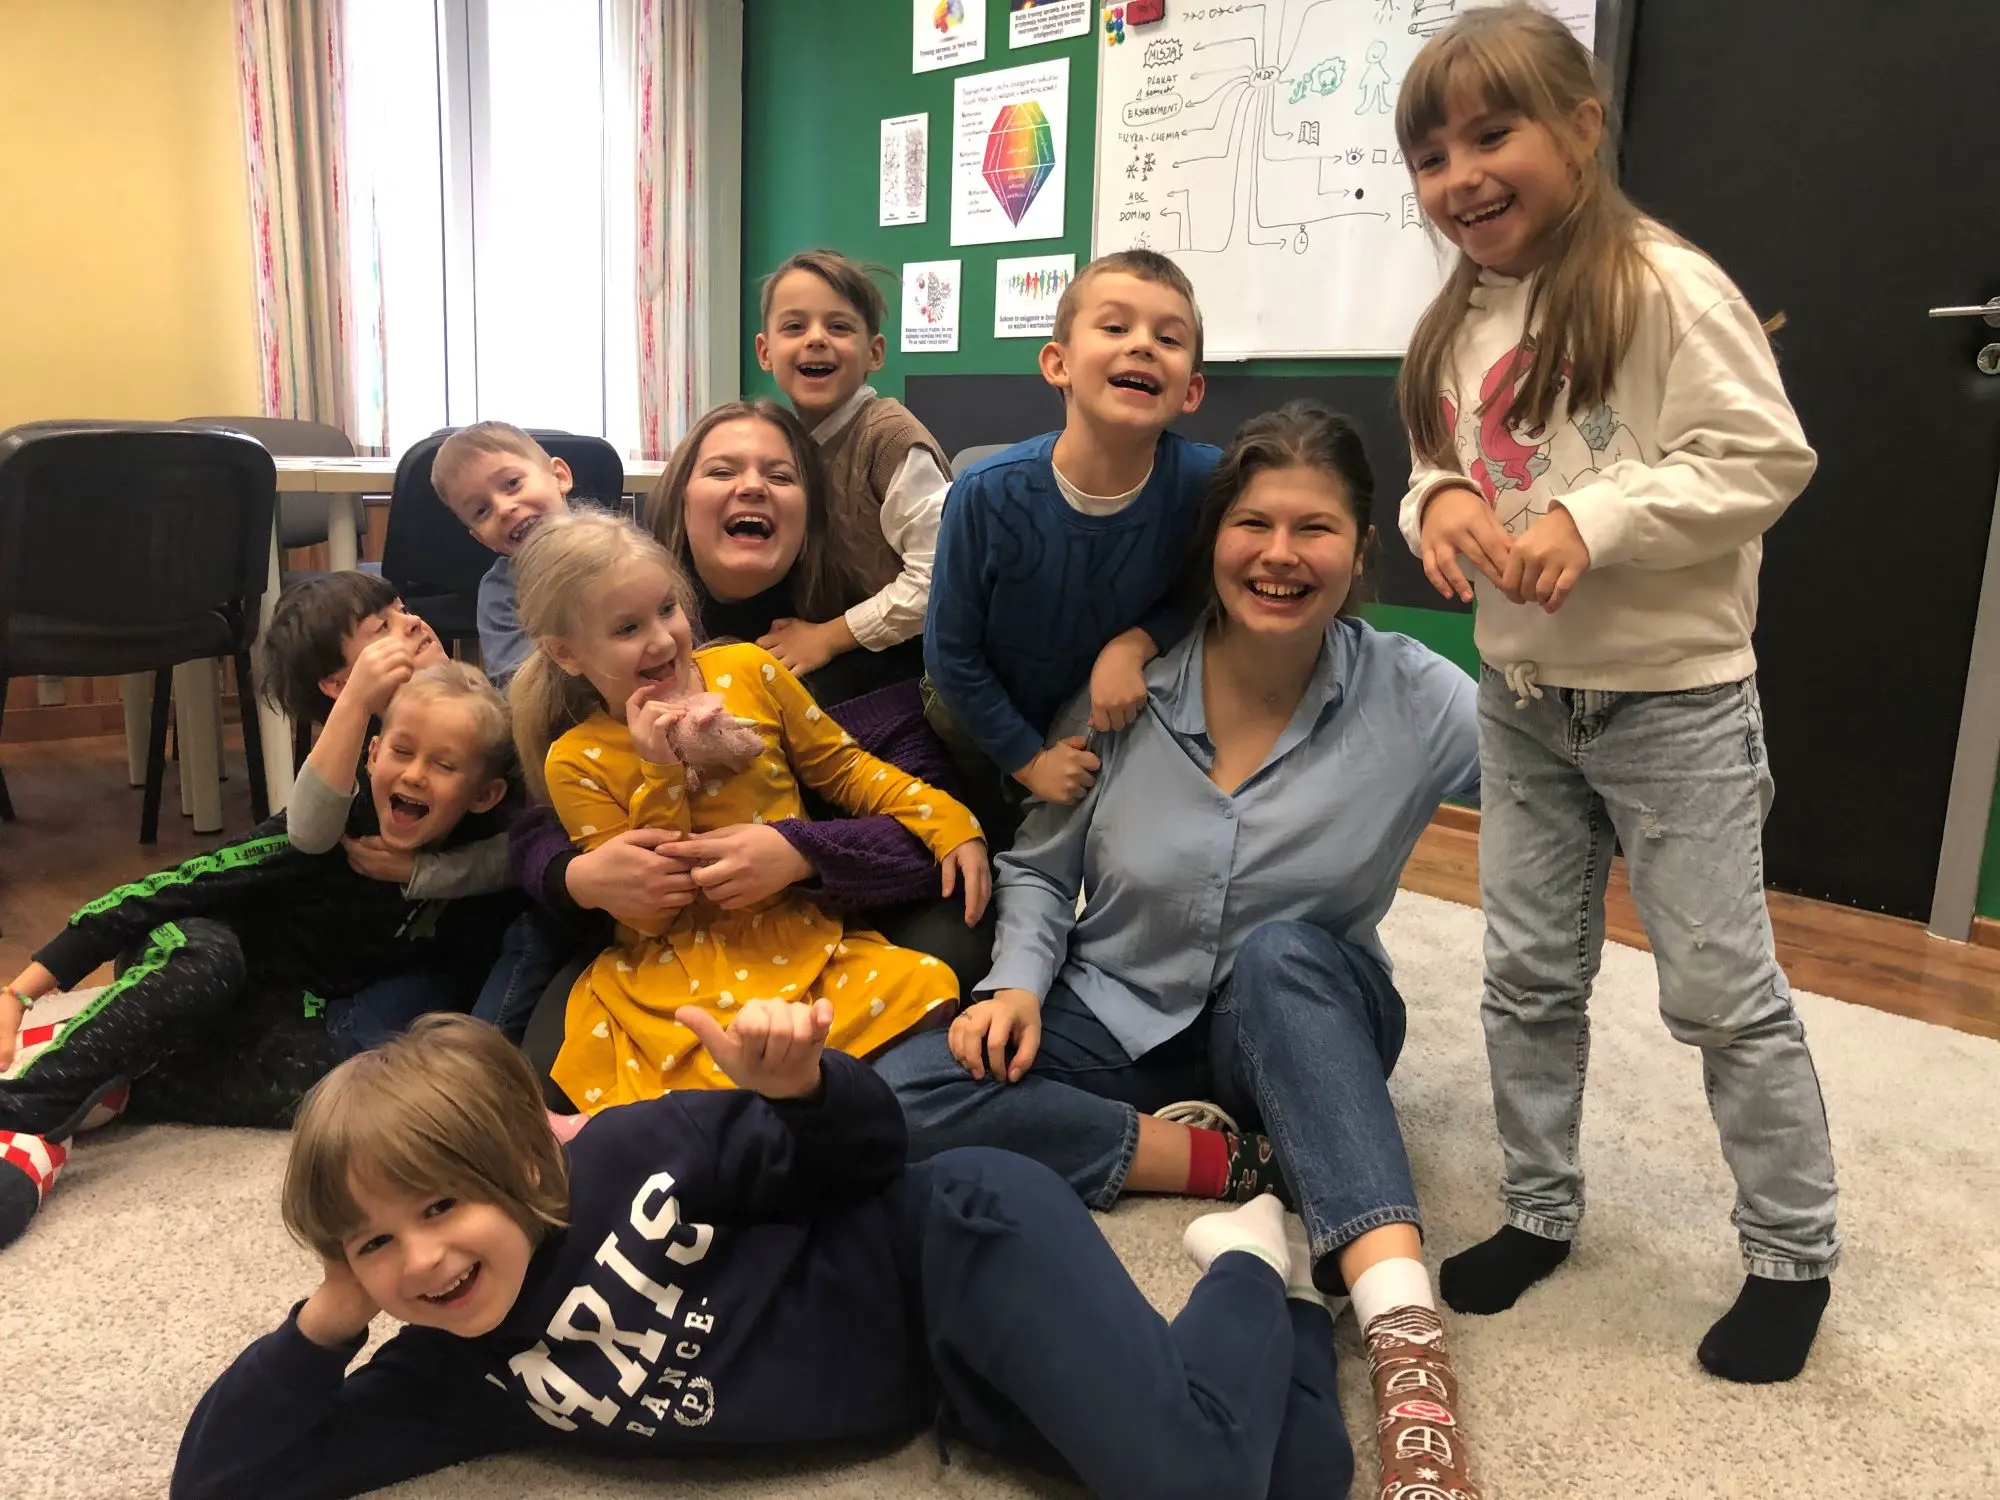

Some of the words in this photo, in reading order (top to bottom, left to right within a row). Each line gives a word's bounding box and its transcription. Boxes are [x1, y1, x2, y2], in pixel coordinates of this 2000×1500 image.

[1148, 47, 1177, 62] MISJA
[1147, 74, 1178, 87] PLAKAT
[1128, 191, 1145, 201] ABC
[1119, 210, 1151, 222] DOMINO
[485, 1171, 715, 1431] ARIS
